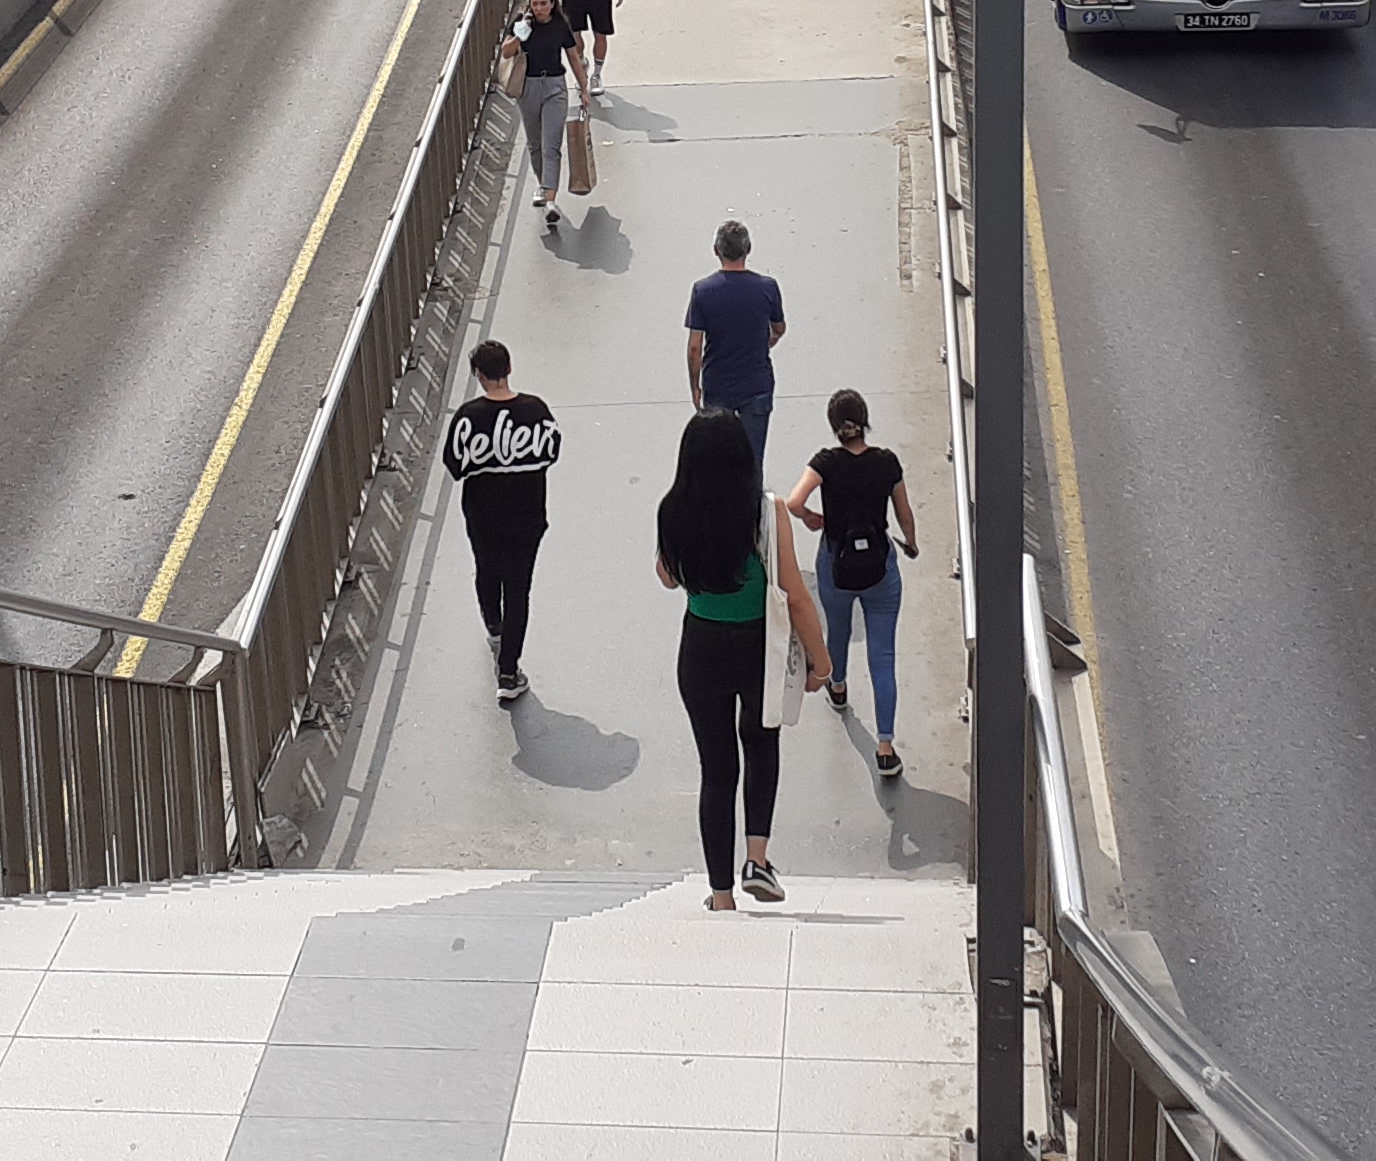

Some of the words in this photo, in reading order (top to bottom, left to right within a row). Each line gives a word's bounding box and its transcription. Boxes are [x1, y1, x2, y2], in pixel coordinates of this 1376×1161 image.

[1186, 16, 1200, 26] 34
[1204, 16, 1219, 26] TN
[1222, 15, 1248, 26] 2760
